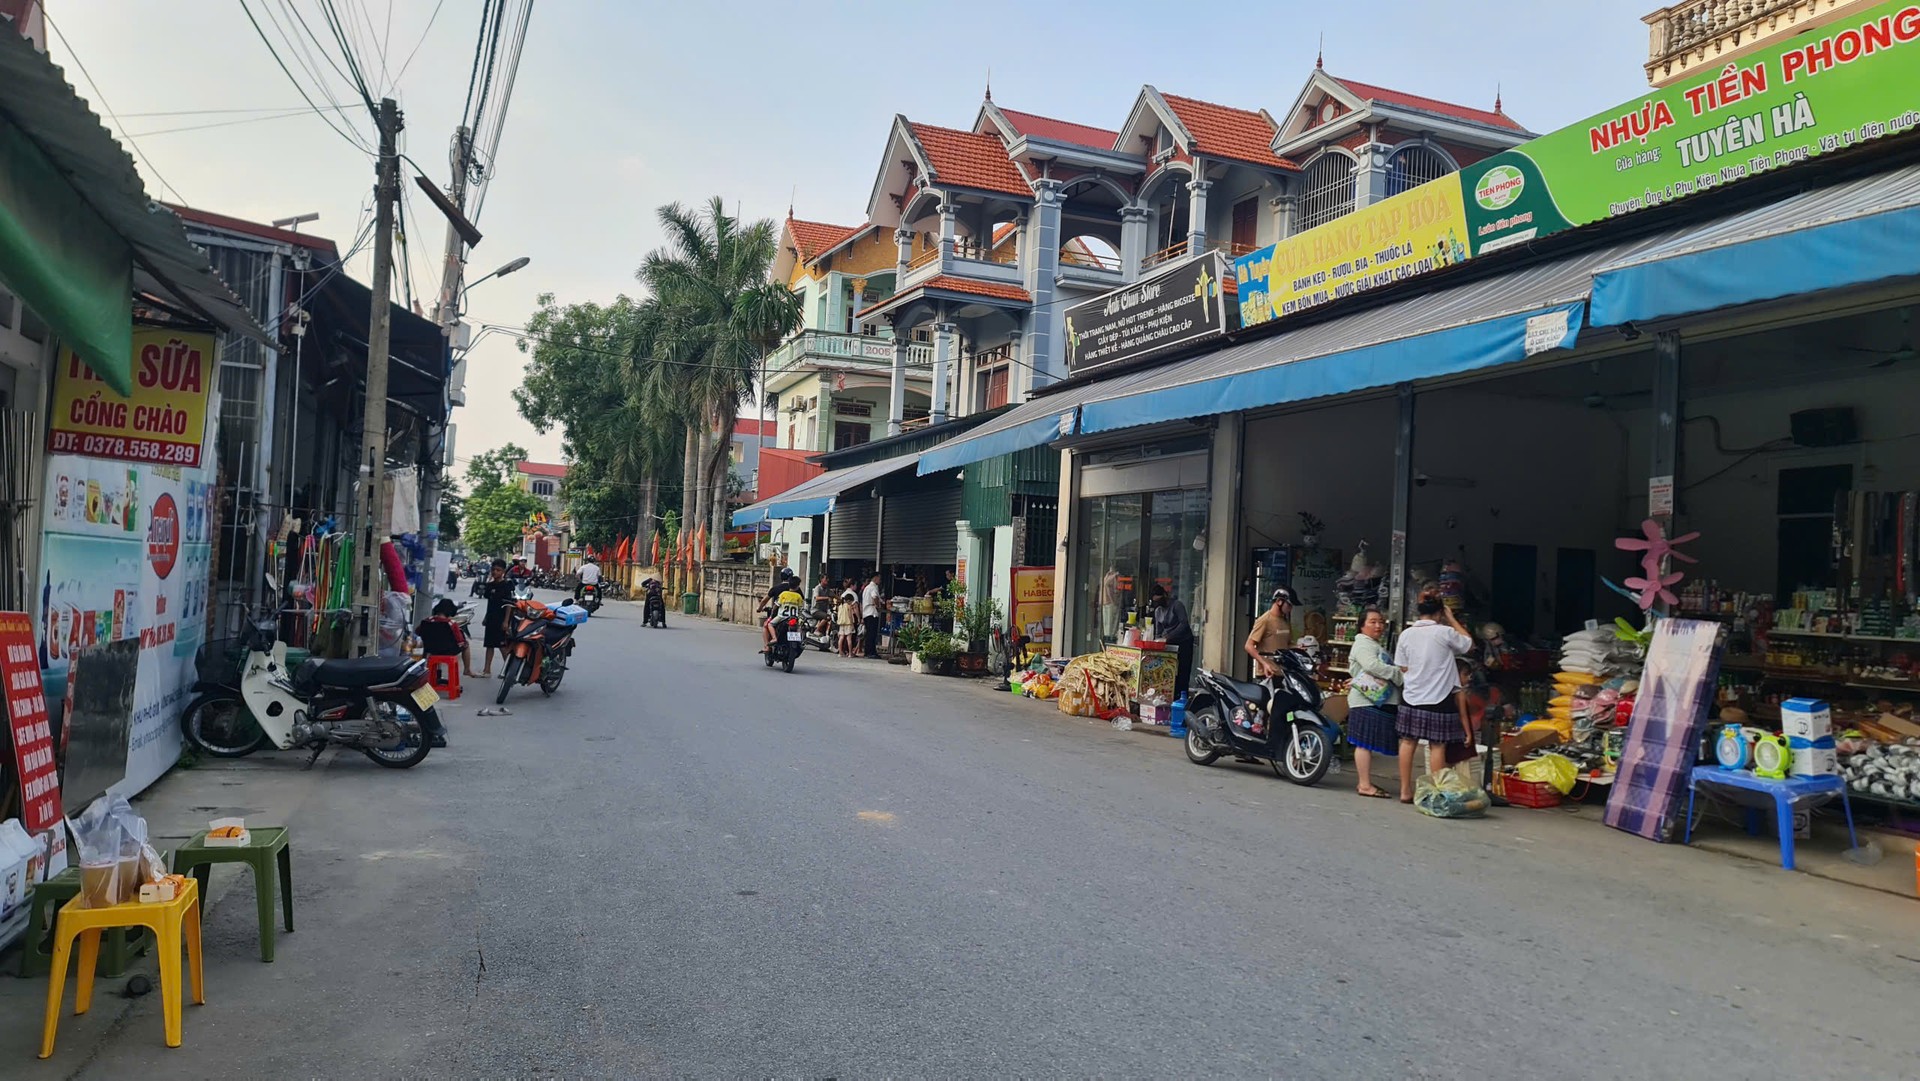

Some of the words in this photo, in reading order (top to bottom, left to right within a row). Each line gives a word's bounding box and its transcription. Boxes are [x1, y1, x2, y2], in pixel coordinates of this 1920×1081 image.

[1590, 101, 1674, 153] NHỰA
[1685, 63, 1767, 115] TIỀN
[1782, 7, 1920, 83] PHONG
[1676, 112, 1765, 168] TUYÊN
[1771, 91, 1816, 138] HÀ
[1615, 156, 1633, 172] Cửa
[1665, 186, 1672, 198] &
[1775, 145, 1808, 164] Phong
[1478, 187, 1495, 199] TIEN
[1496, 177, 1522, 192] PHONG
[1312, 222, 1362, 264] HÀNG
[1365, 206, 1403, 246] TẠP
[1406, 187, 1453, 231] HÓA
[1282, 299, 1297, 315] KEM
[1298, 293, 1312, 309] BỐN
[1395, 263, 1412, 280] CÁC
[1413, 257, 1433, 275] LOẠI
[1293, 275, 1311, 292] BÁNH
[1313, 271, 1326, 286] KẸO
[1355, 257, 1369, 272] BIA
[1375, 243, 1400, 265] THUỐC
[1089, 325, 1105, 337] TRANG
[1105, 321, 1118, 332] NAM,
[1126, 314, 1136, 324] HOT
[1137, 308, 1154, 320] TREND
[1158, 301, 1174, 313] HÀNG
[1174, 293, 1195, 308] BIGSIZE
[1141, 284, 1160, 304] Store
[1085, 349, 1098, 361] HÀNG
[1121, 337, 1135, 350] HÀNG
[1154, 327, 1168, 339] CHÂU
[1169, 324, 1180, 334] CAO
[1131, 323, 1144, 335] XÁCH
[1148, 318, 1159, 329] PHỤ
[1159, 313, 1172, 325] KIỆN
[138, 338, 201, 393] SỮA
[70, 390, 127, 429] CỔNG
[133, 403, 188, 435] CHÀO
[54, 432, 79, 450] ĐT:
[83, 437, 195, 463] 0378.558.289
[782, 605, 798, 617] 20
